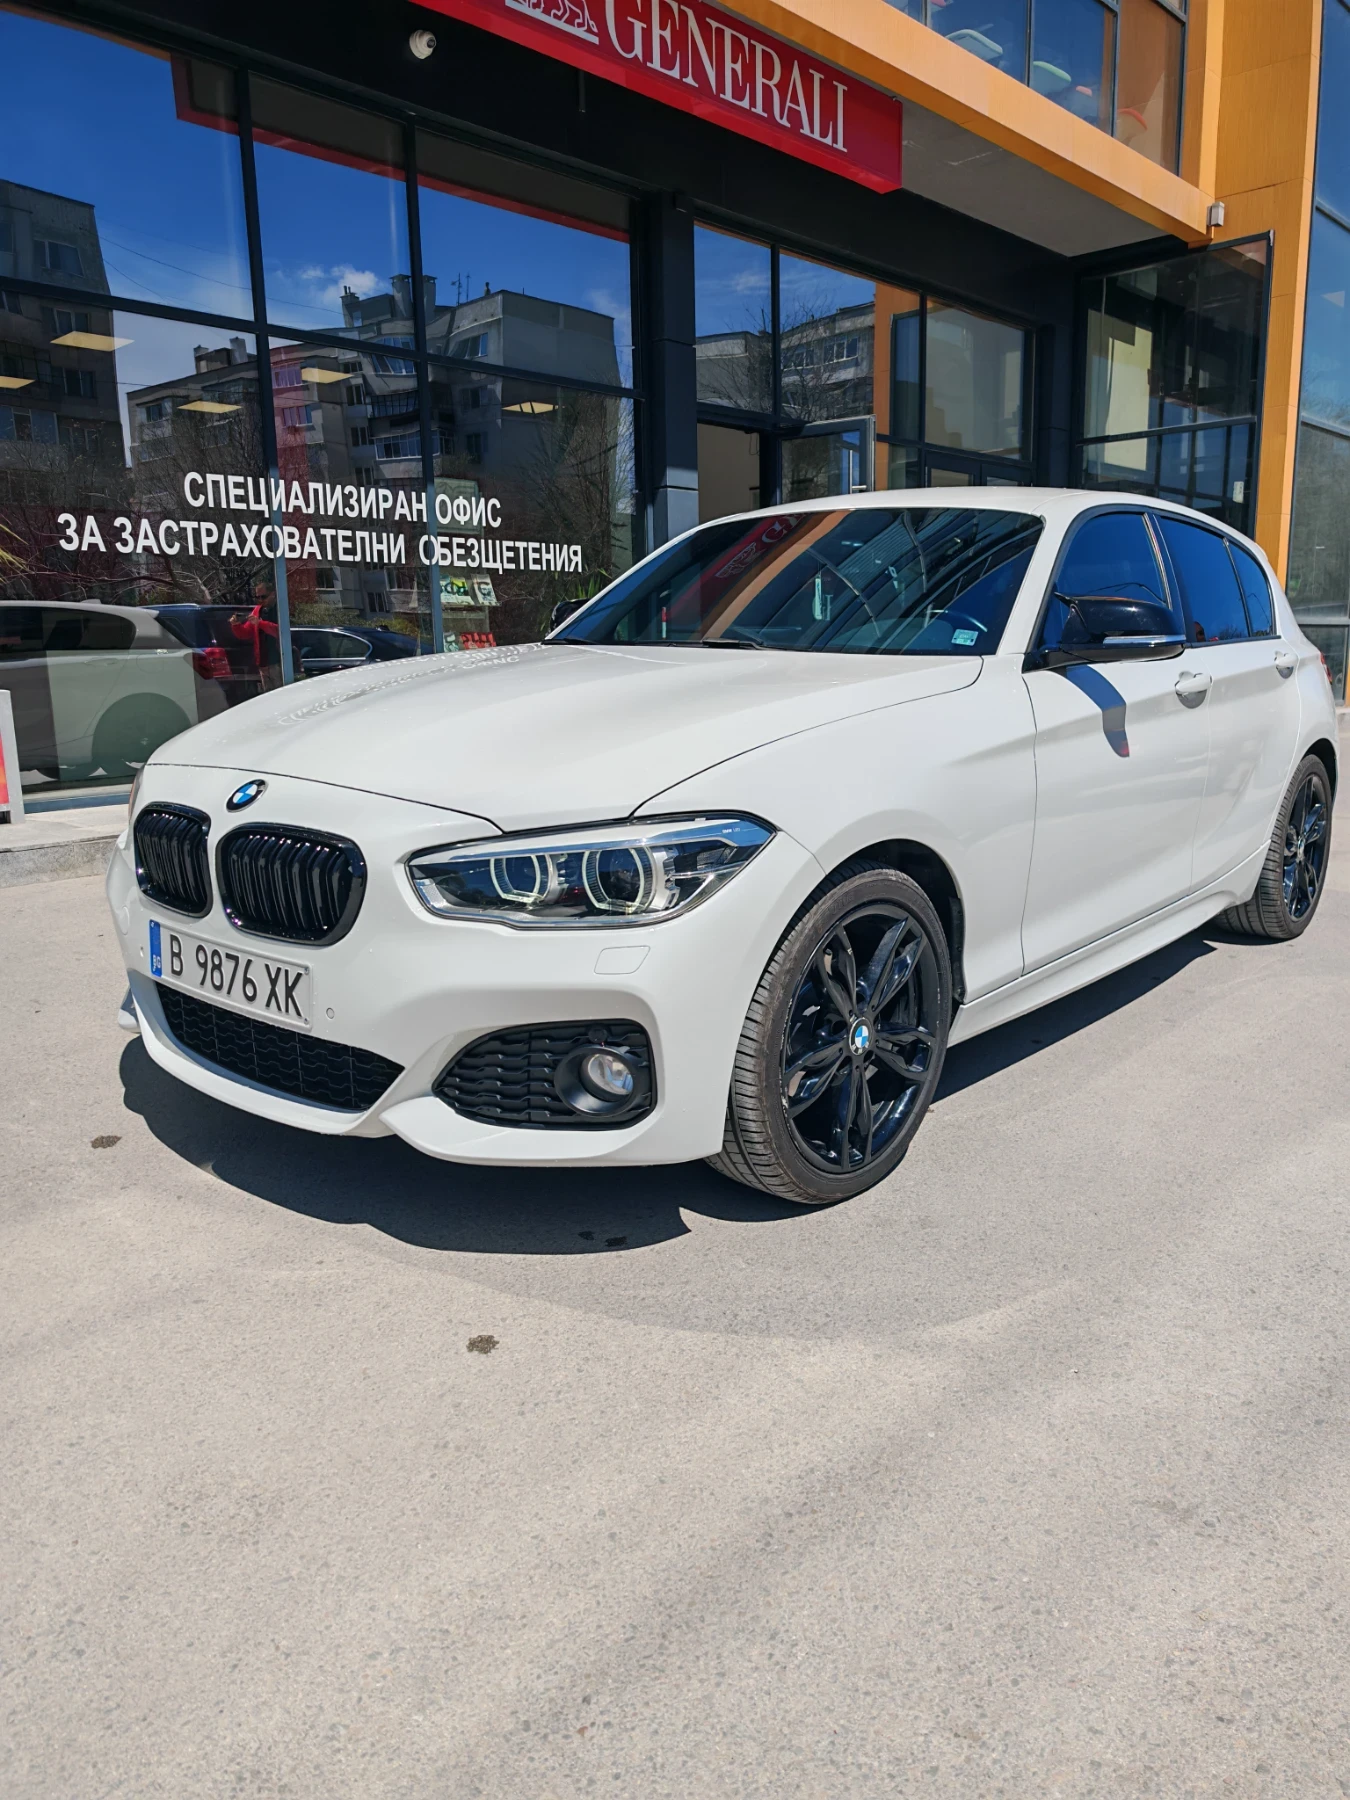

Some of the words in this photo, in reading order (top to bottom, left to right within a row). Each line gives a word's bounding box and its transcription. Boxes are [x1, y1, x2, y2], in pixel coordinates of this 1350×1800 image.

[605, 0, 848, 152] GENERALI
[184, 471, 428, 522] СПЕЦИАЛИЗИРАН
[435, 493, 502, 528] ОФИС
[57, 512, 107, 552] ЗА
[113, 516, 406, 565] ЗАСТРАХОВАТЕЛНИ
[418, 534, 583, 575] ОБЕЗЩЕТЕНИЯ
[195, 944, 257, 1002] 9876
